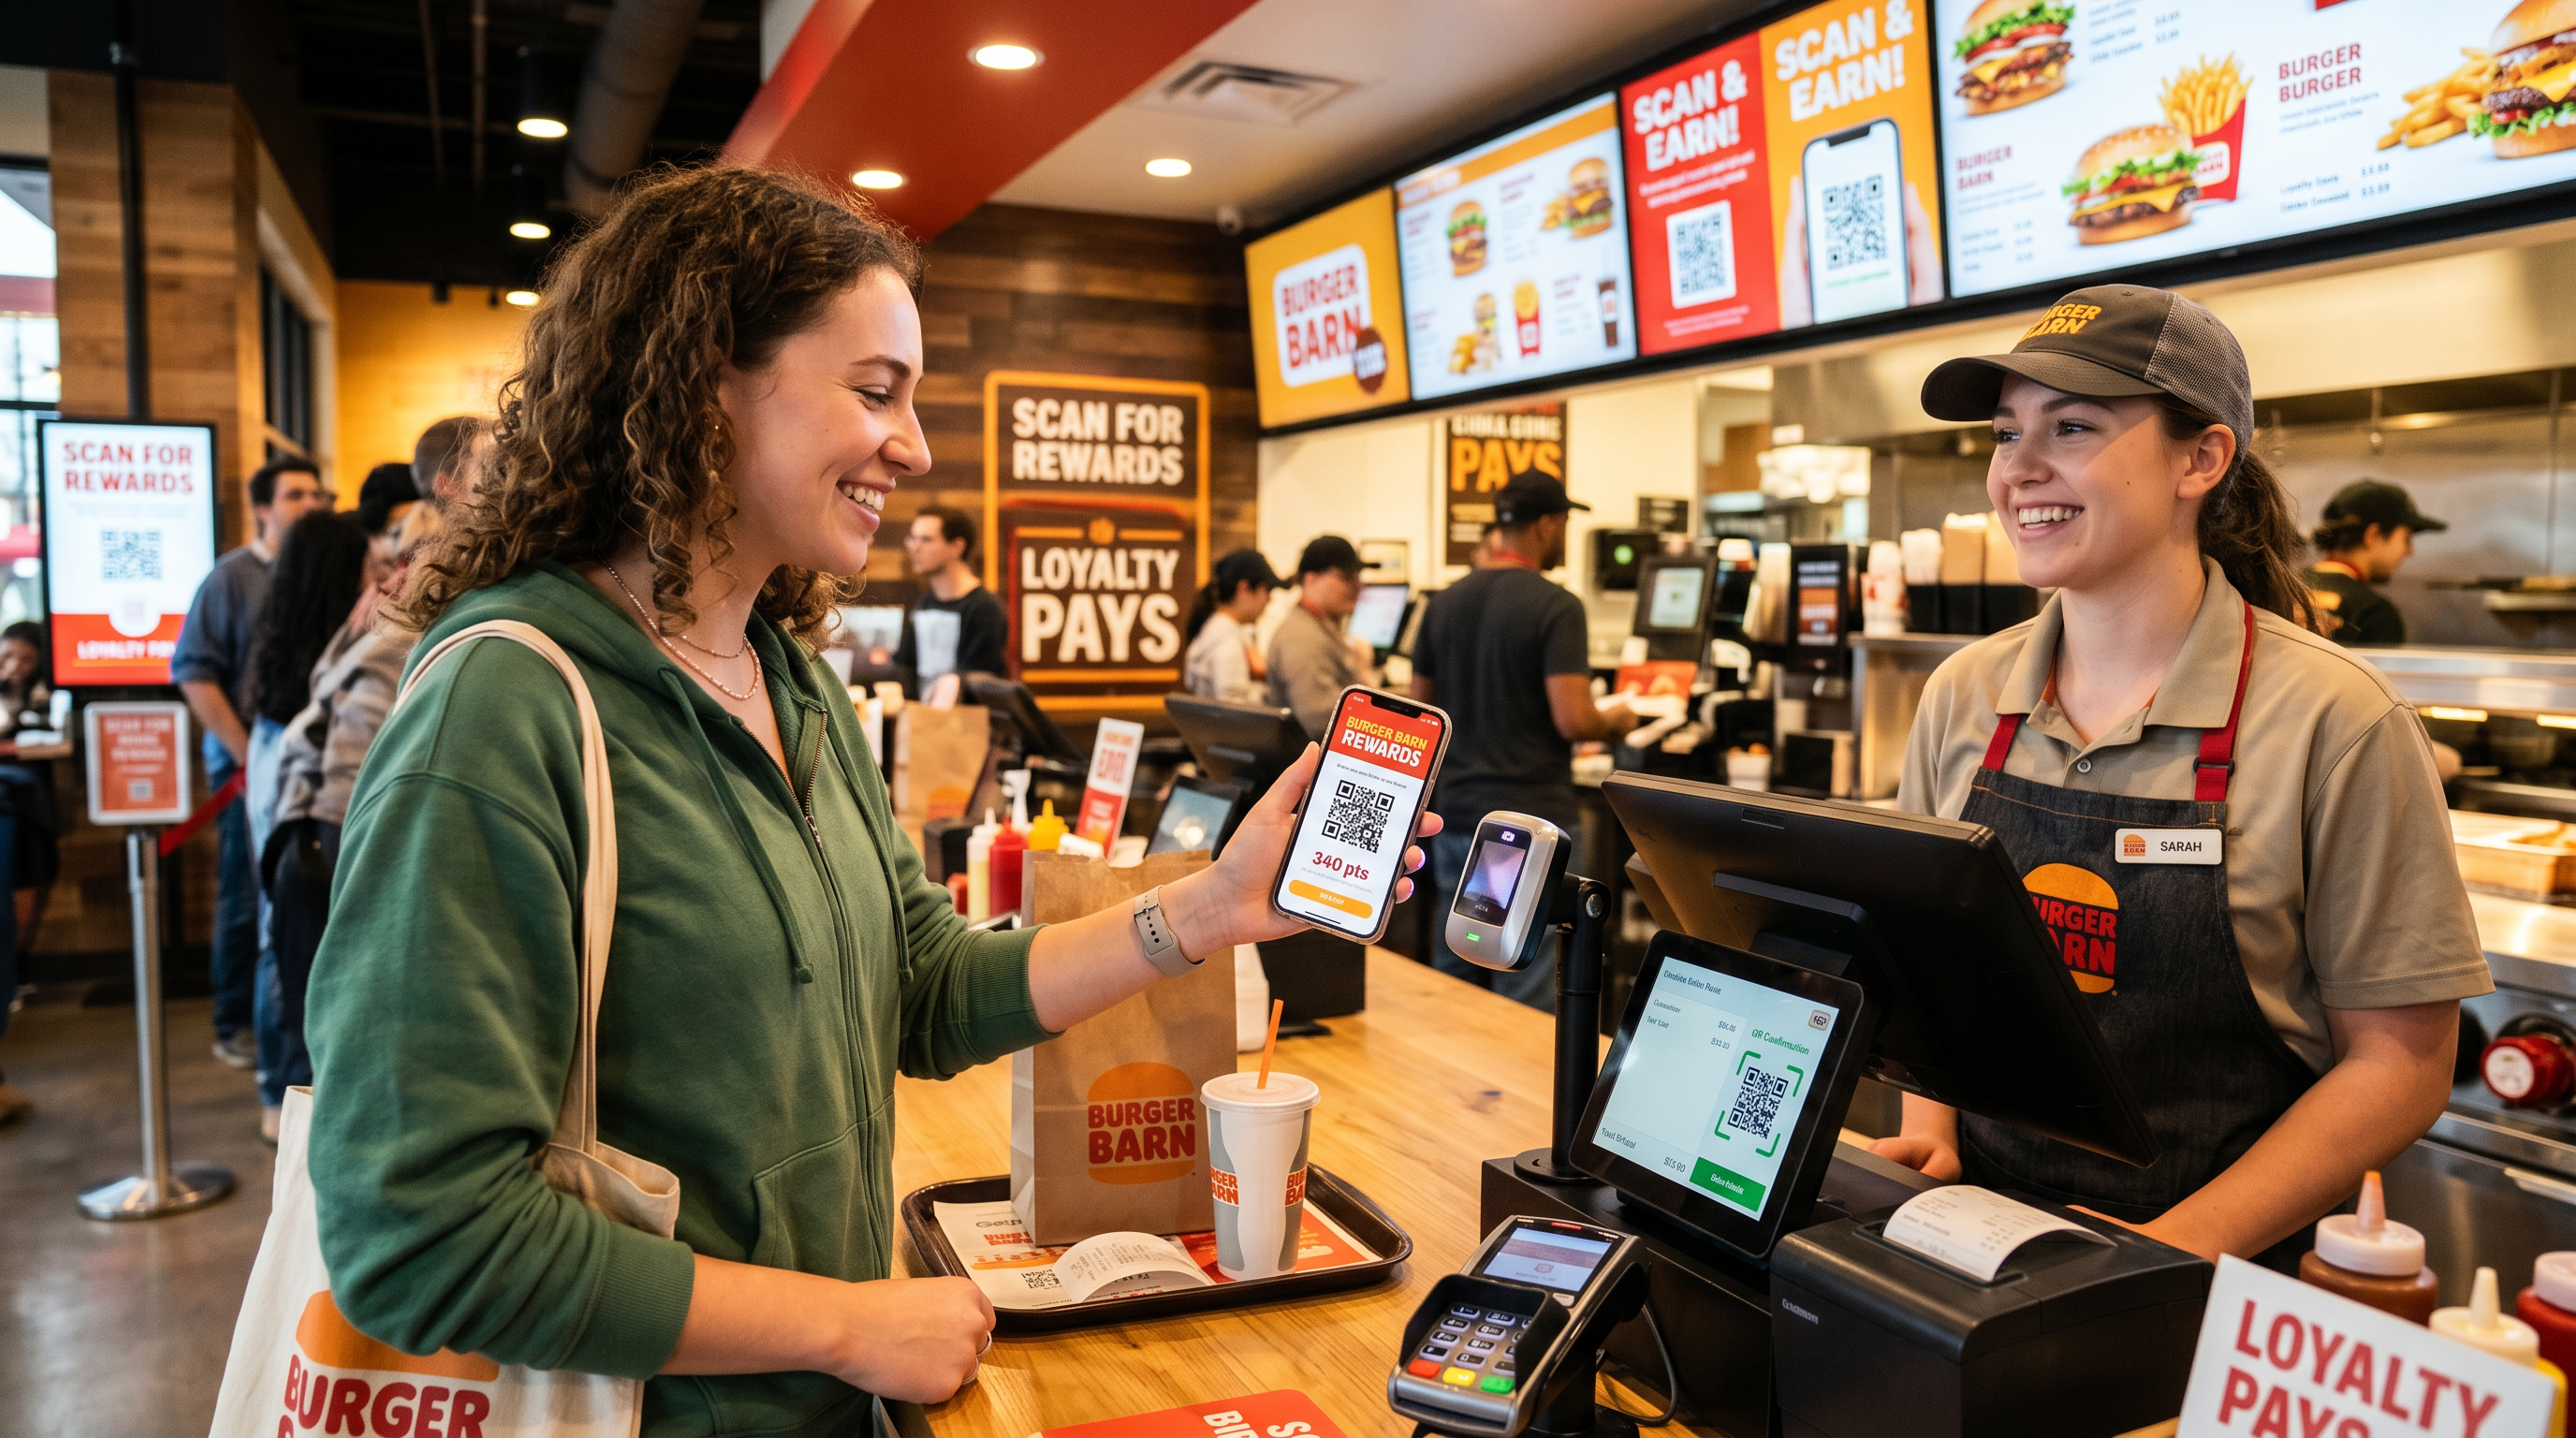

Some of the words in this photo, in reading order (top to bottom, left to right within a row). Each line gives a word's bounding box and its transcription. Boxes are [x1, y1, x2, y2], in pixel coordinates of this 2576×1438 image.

[1776, 7, 1876, 81] SCAN
[1885, 0, 1914, 40] &
[2279, 43, 2361, 80] BURGER
[1633, 69, 1717, 134] SCAN
[1721, 60, 1748, 101] &
[1790, 44, 1905, 122] EARN!
[2280, 67, 2361, 102] BURGER
[1646, 106, 1740, 171] EARN!
[1281, 264, 1359, 317] BURGER
[1286, 305, 1363, 369] BARN
[2019, 318, 2088, 344] ARN
[1013, 397, 1109, 441] SCAN
[1115, 403, 1183, 445] FOR
[64, 441, 133, 465] SCAN
[144, 444, 194, 466] FOR
[1013, 440, 1184, 486] REWARDS
[65, 470, 194, 493] REWARDS
[1021, 547, 1180, 590] LOYALTY
[1021, 594, 1181, 663] PAYS
[1340, 728, 1422, 767] REWARDS
[1346, 716, 1394, 741] BURGER
[1394, 730, 1428, 751] BARN
[1312, 851, 1343, 872] 340
[1342, 863, 1369, 881] pts
[2160, 842, 2202, 852] SARAH
[2032, 896, 2117, 939] URGER
[2047, 927, 2116, 976] RN
[1088, 1097, 1196, 1129] BURGER
[1088, 1123, 1196, 1165] BARN
[1211, 1181, 1239, 1206] ARN
[1284, 1184, 1306, 1207] BA
[2234, 1298, 2502, 1438] LOYALTY
[284, 1354, 490, 1438] BURGER
